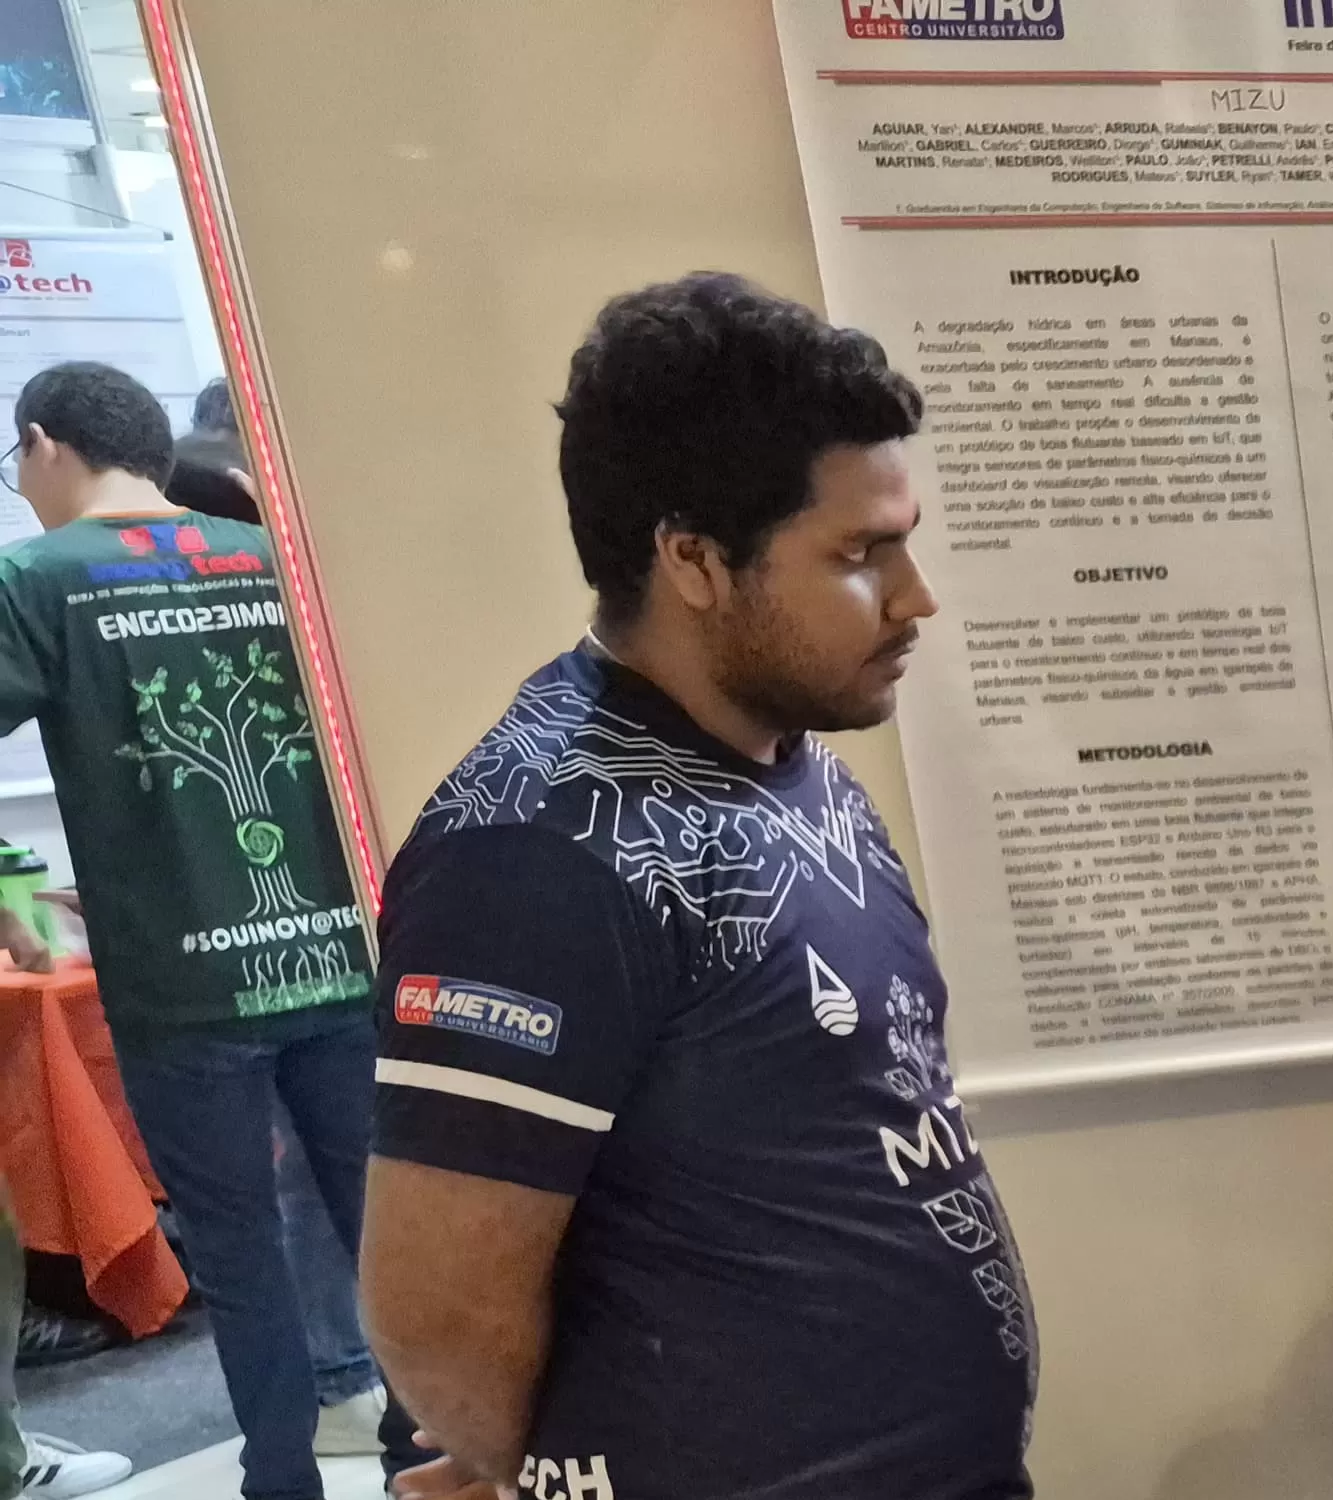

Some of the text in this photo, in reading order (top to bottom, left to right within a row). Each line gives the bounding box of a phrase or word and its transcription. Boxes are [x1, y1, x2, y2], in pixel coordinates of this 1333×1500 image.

[854, 21, 1057, 38] CENTRO UNIVERSITÁRIO
[1288, 40, 1322, 52] Feira
[1211, 88, 1285, 112] MIZU
[1010, 265, 1141, 286] INTRODUÇÃO
[1073, 566, 1169, 584] OBJETIVO
[1078, 740, 1213, 764] METODOLOGIA
[182, 904, 362, 954] #SOUINOV@TEC
[400, 986, 554, 1038] FAMETRO
